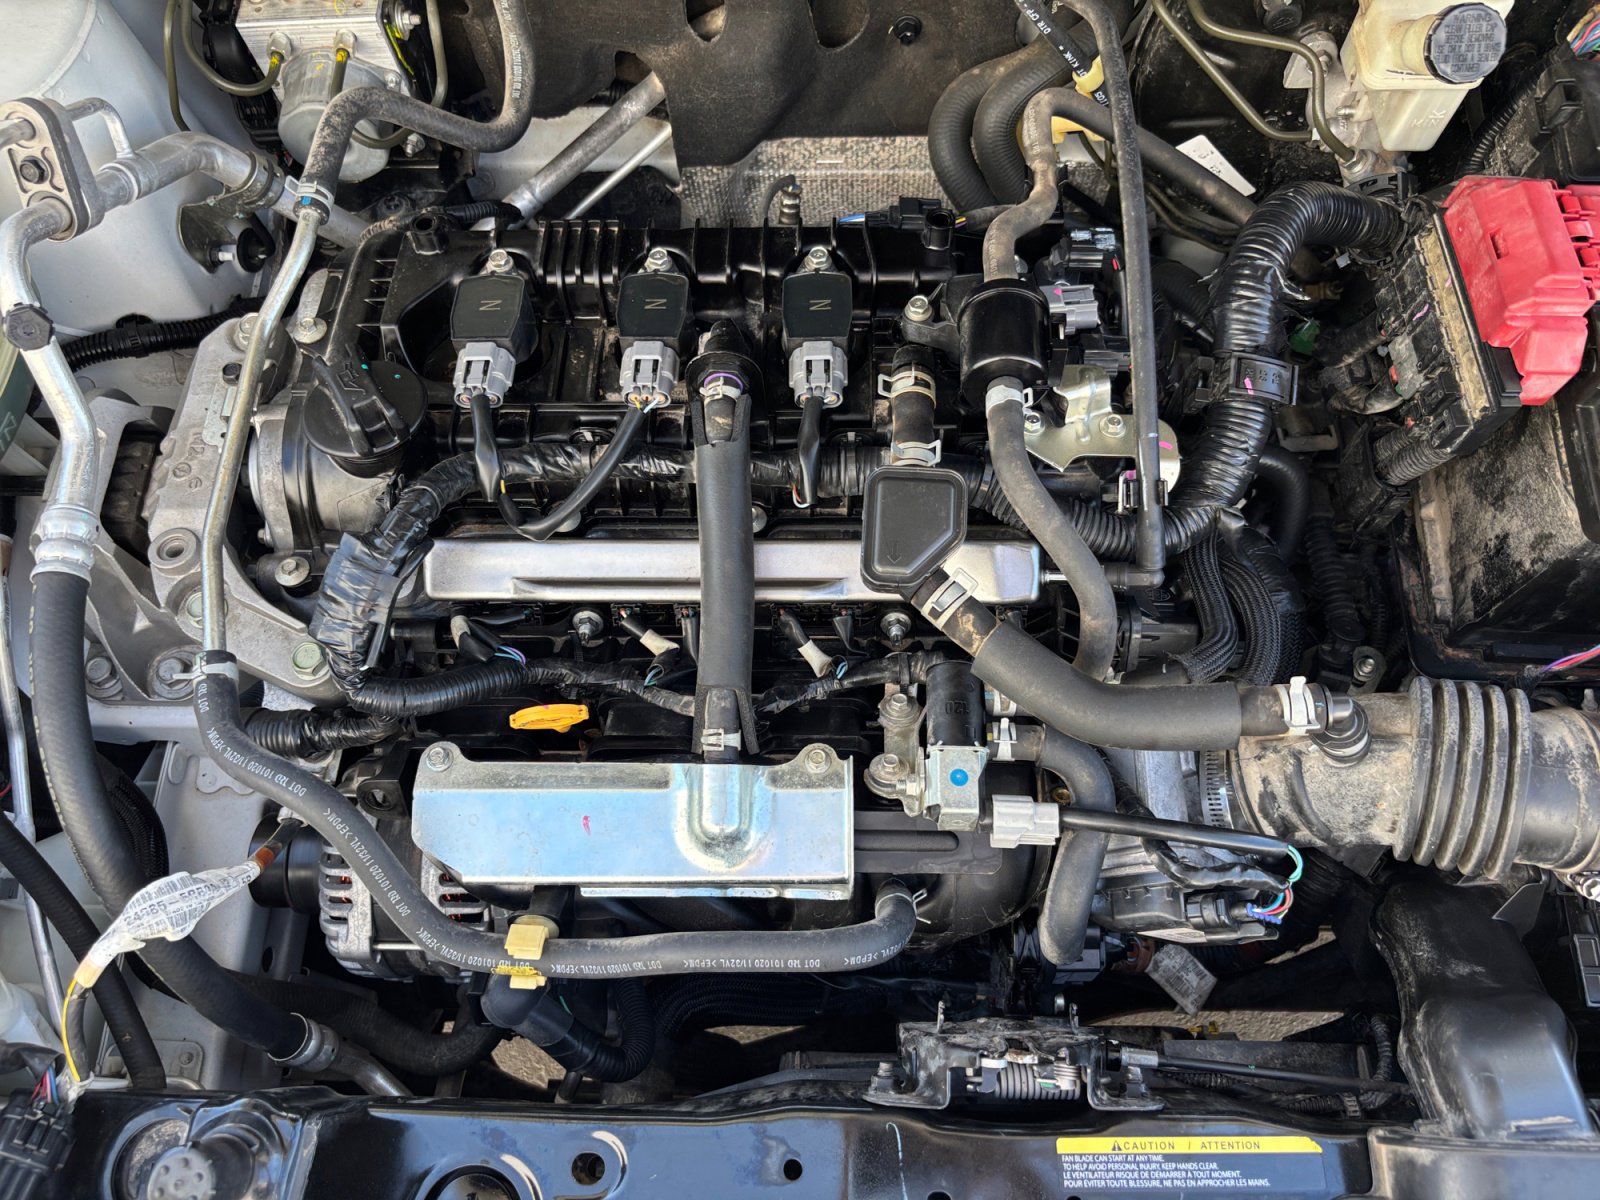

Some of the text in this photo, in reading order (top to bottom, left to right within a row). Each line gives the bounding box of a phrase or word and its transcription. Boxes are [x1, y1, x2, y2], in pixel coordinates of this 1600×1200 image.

[1026, 9, 1040, 20] CFP
[1037, 20, 1052, 34] DTR
[1063, 51, 1080, 68] KINK
[198, 696, 210, 713] DOT
[247, 761, 274, 779] 101020
[288, 782, 307, 796] DOT
[370, 865, 392, 891] 101020
[396, 902, 412, 917] DOT
[468, 956, 496, 968] 101020
[648, 960, 661, 969] DOT
[683, 959, 717, 968] >EPDM<
[754, 959, 784, 968] 101020
[804, 959, 820, 968] DOT
[844, 952, 878, 966] >EPDM<
[607, 962, 632, 973] 101020
[1124, 1141, 1175, 1150] CAUTION
[1200, 1141, 1260, 1150] ATTENTION
[1199, 1162, 1219, 1170] CLEAR.
[1194, 1170, 1210, 1178] TOUT
[1212, 1170, 1242, 1178] MOMENT.
[1064, 1180, 1083, 1188] POUR
